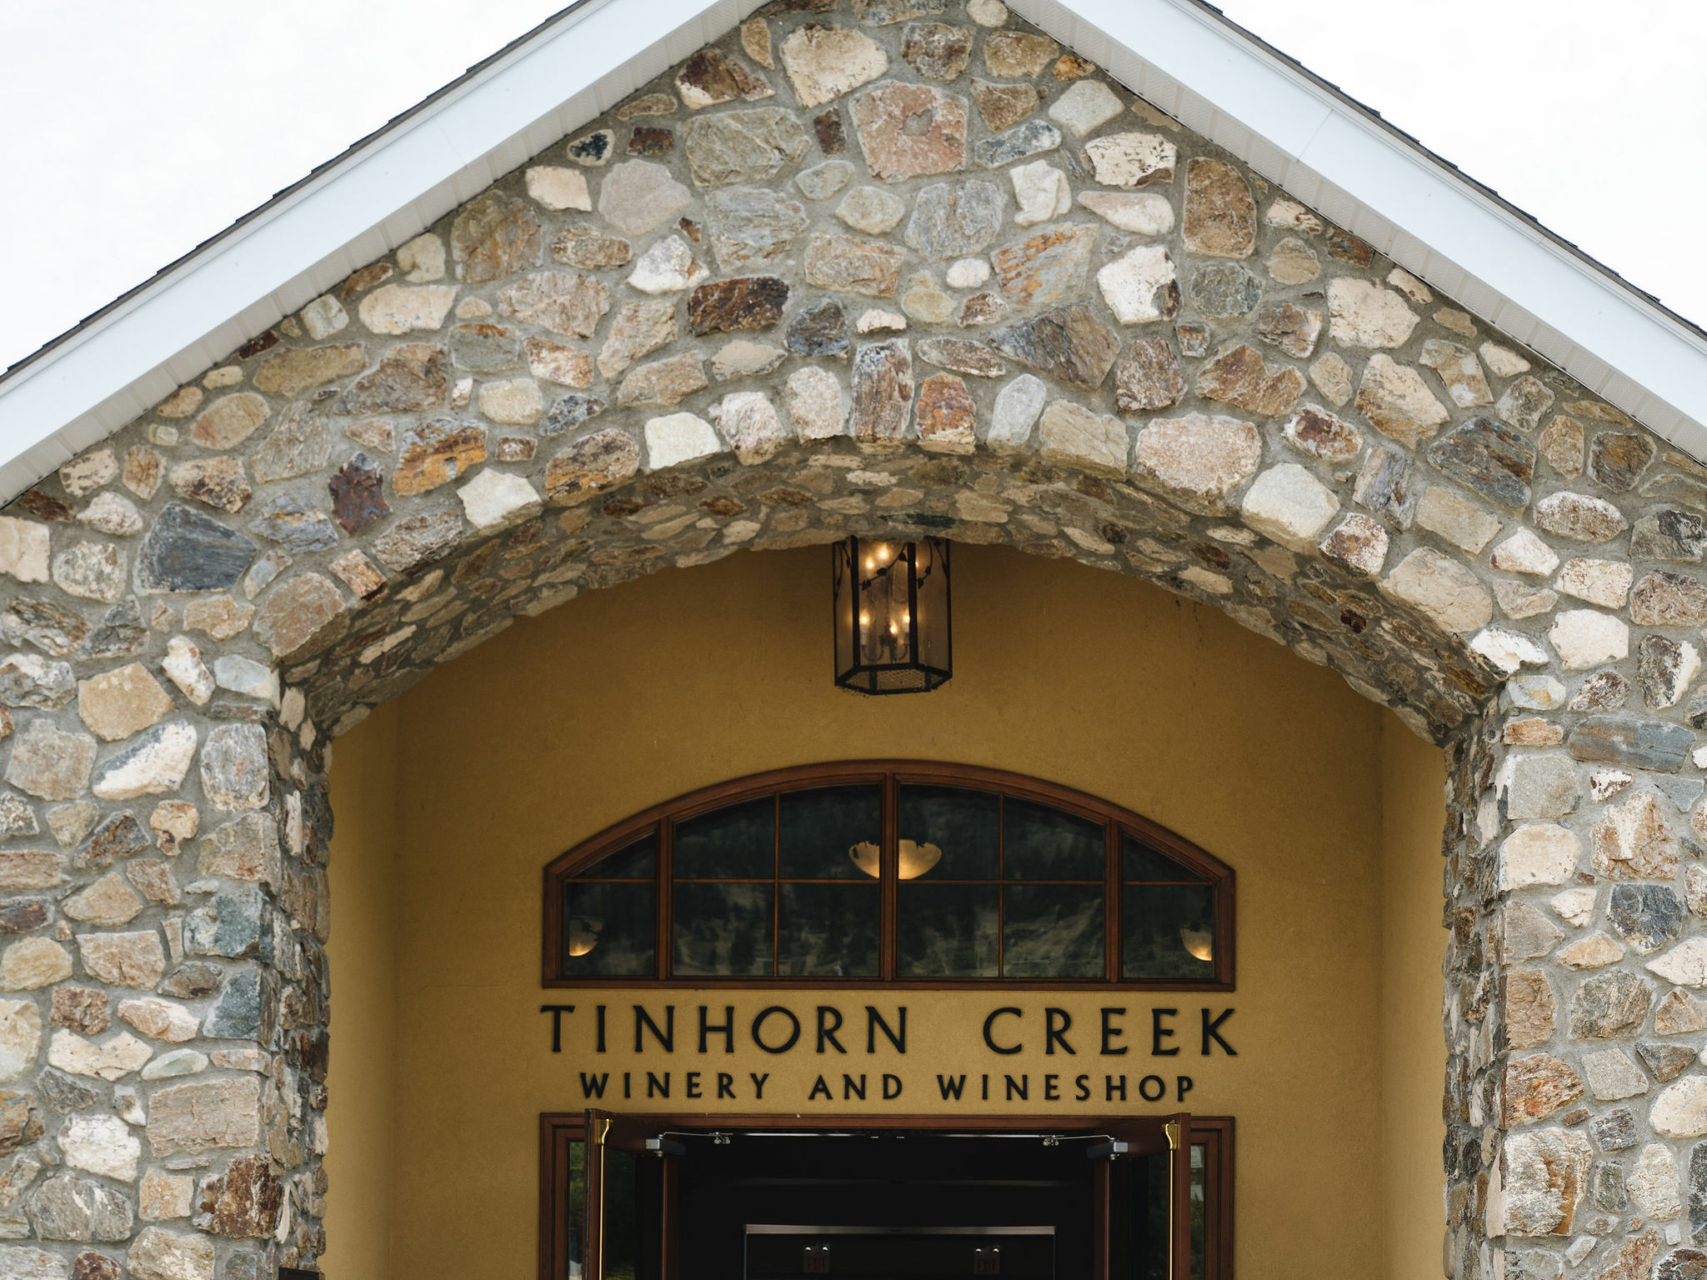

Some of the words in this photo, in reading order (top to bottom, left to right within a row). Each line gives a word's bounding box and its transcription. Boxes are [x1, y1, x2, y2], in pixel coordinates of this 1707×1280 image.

[540, 1005, 907, 1054] TINHORN
[982, 1006, 1239, 1057] CREEK
[580, 1072, 770, 1100] WINERY
[808, 1073, 903, 1100] AND
[937, 1074, 1195, 1102] WINESHOP
